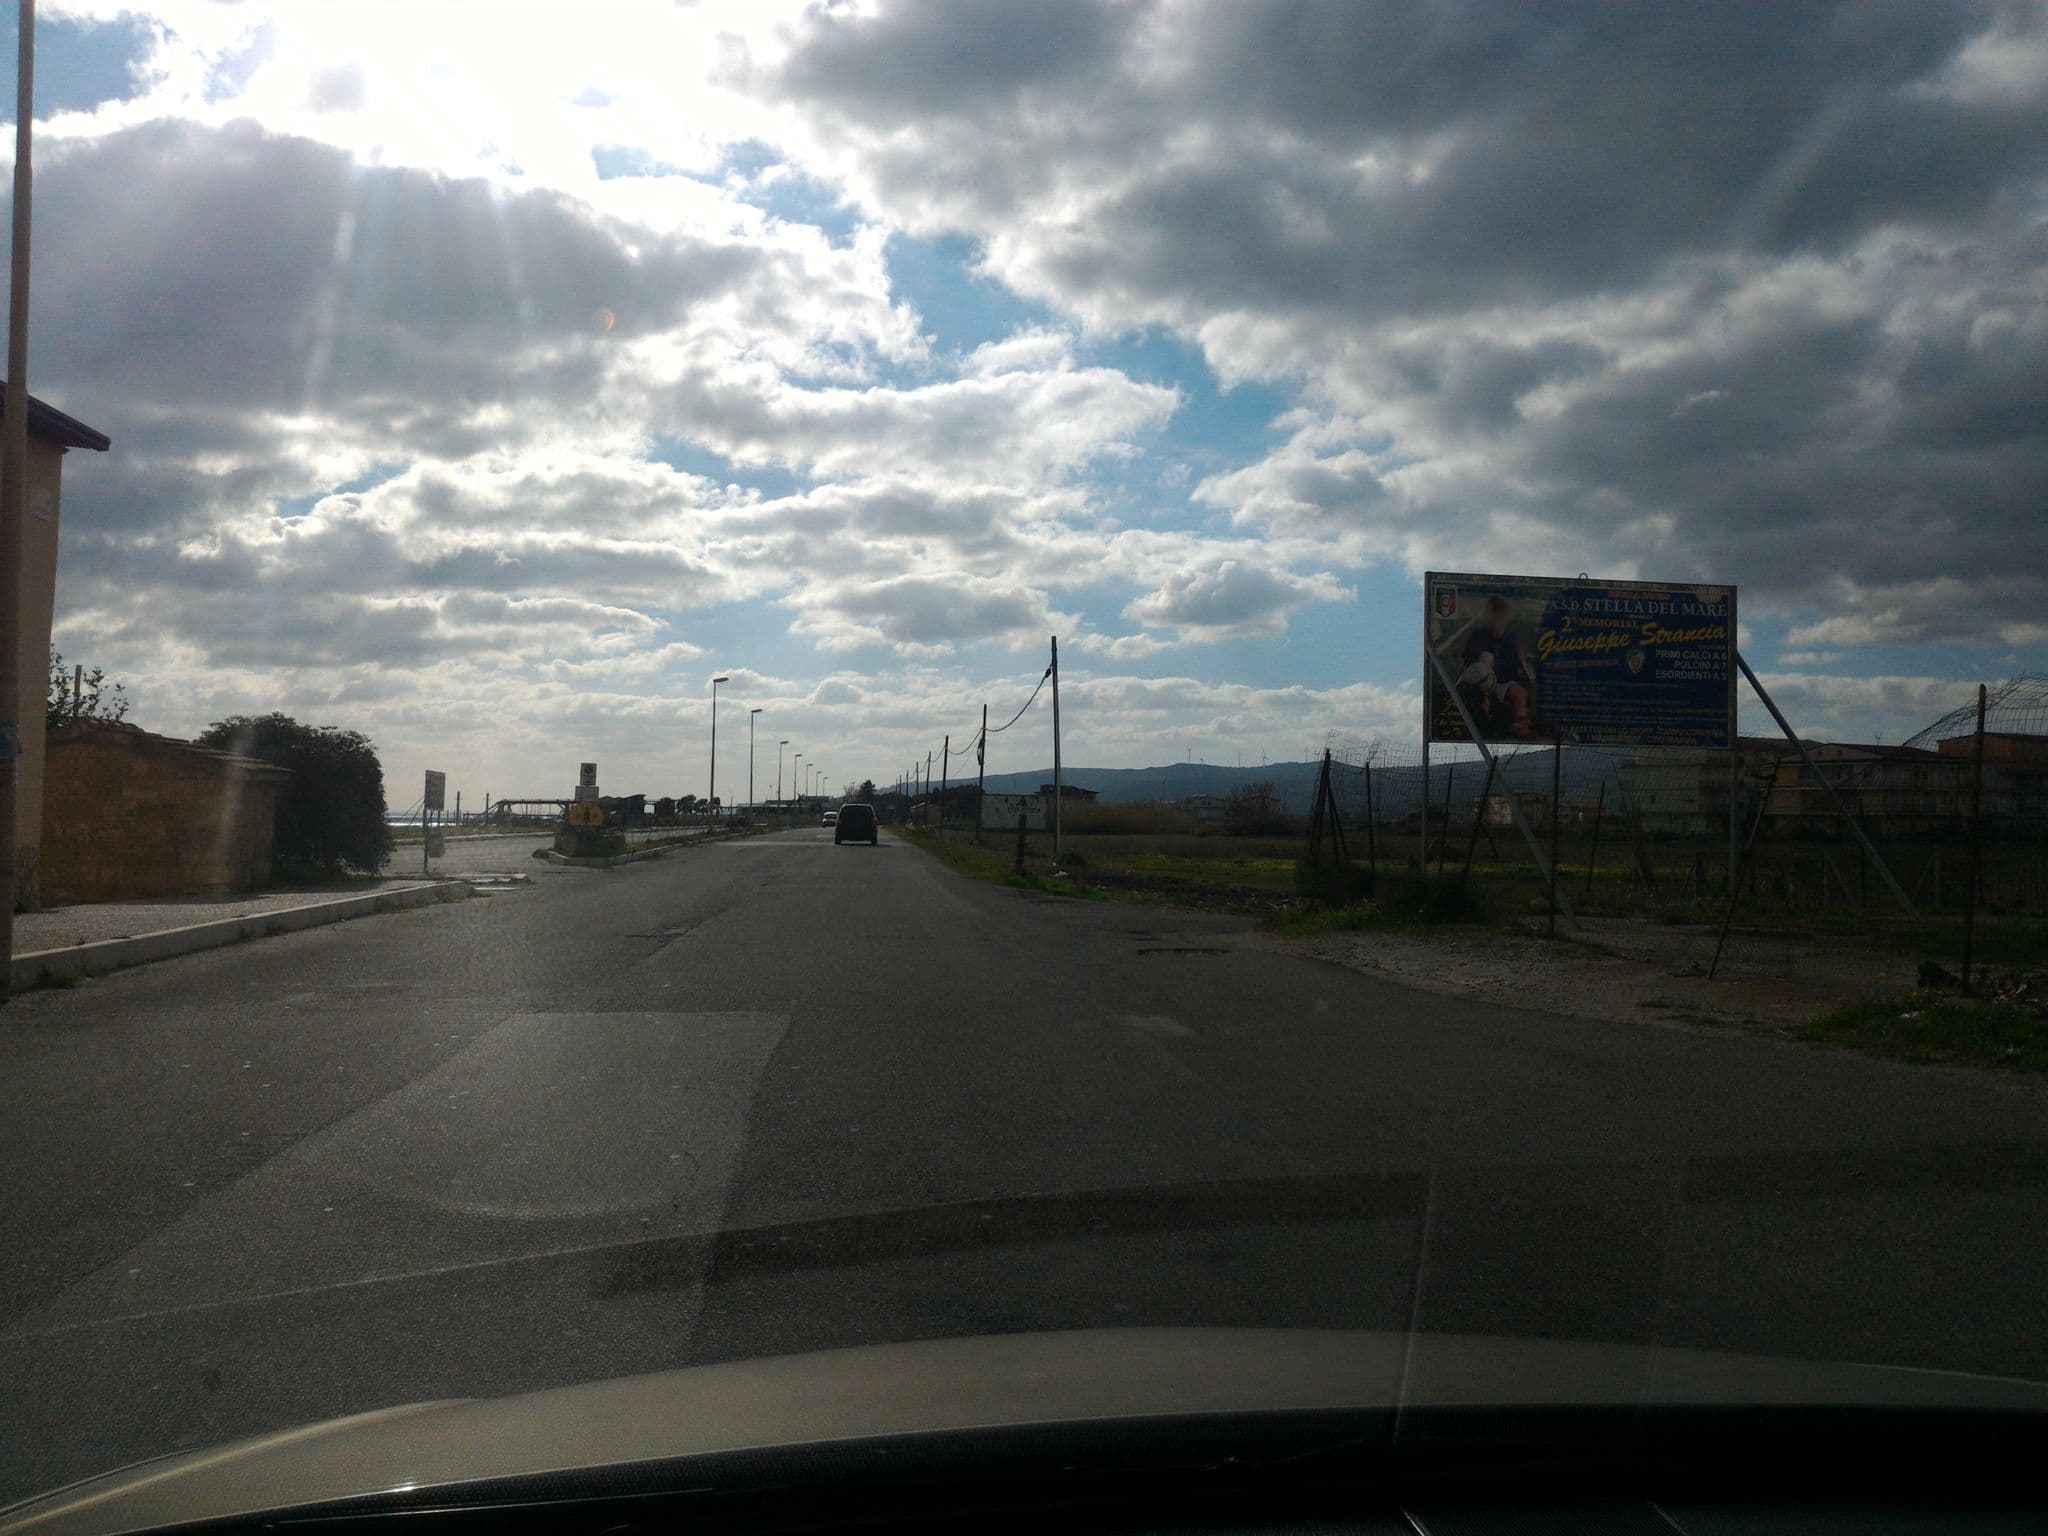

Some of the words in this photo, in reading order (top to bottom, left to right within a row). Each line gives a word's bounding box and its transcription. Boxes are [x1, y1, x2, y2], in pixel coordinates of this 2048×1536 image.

[1583, 599, 1646, 613] STELLA
[1648, 601, 1680, 615] DEL
[1681, 602, 1728, 617] MARE
[1536, 629, 1632, 662] Giuseppe
[1656, 649, 1681, 659] PRIMI
[1682, 650, 1710, 659] CALCI
[1712, 651, 1719, 661] A
[1674, 660, 1711, 670] PULCINI
[1712, 662, 1719, 670] A
[1721, 661, 1727, 670] 7
[1656, 670, 1711, 680] ESORDIENTI
[1712, 671, 1719, 680] A
